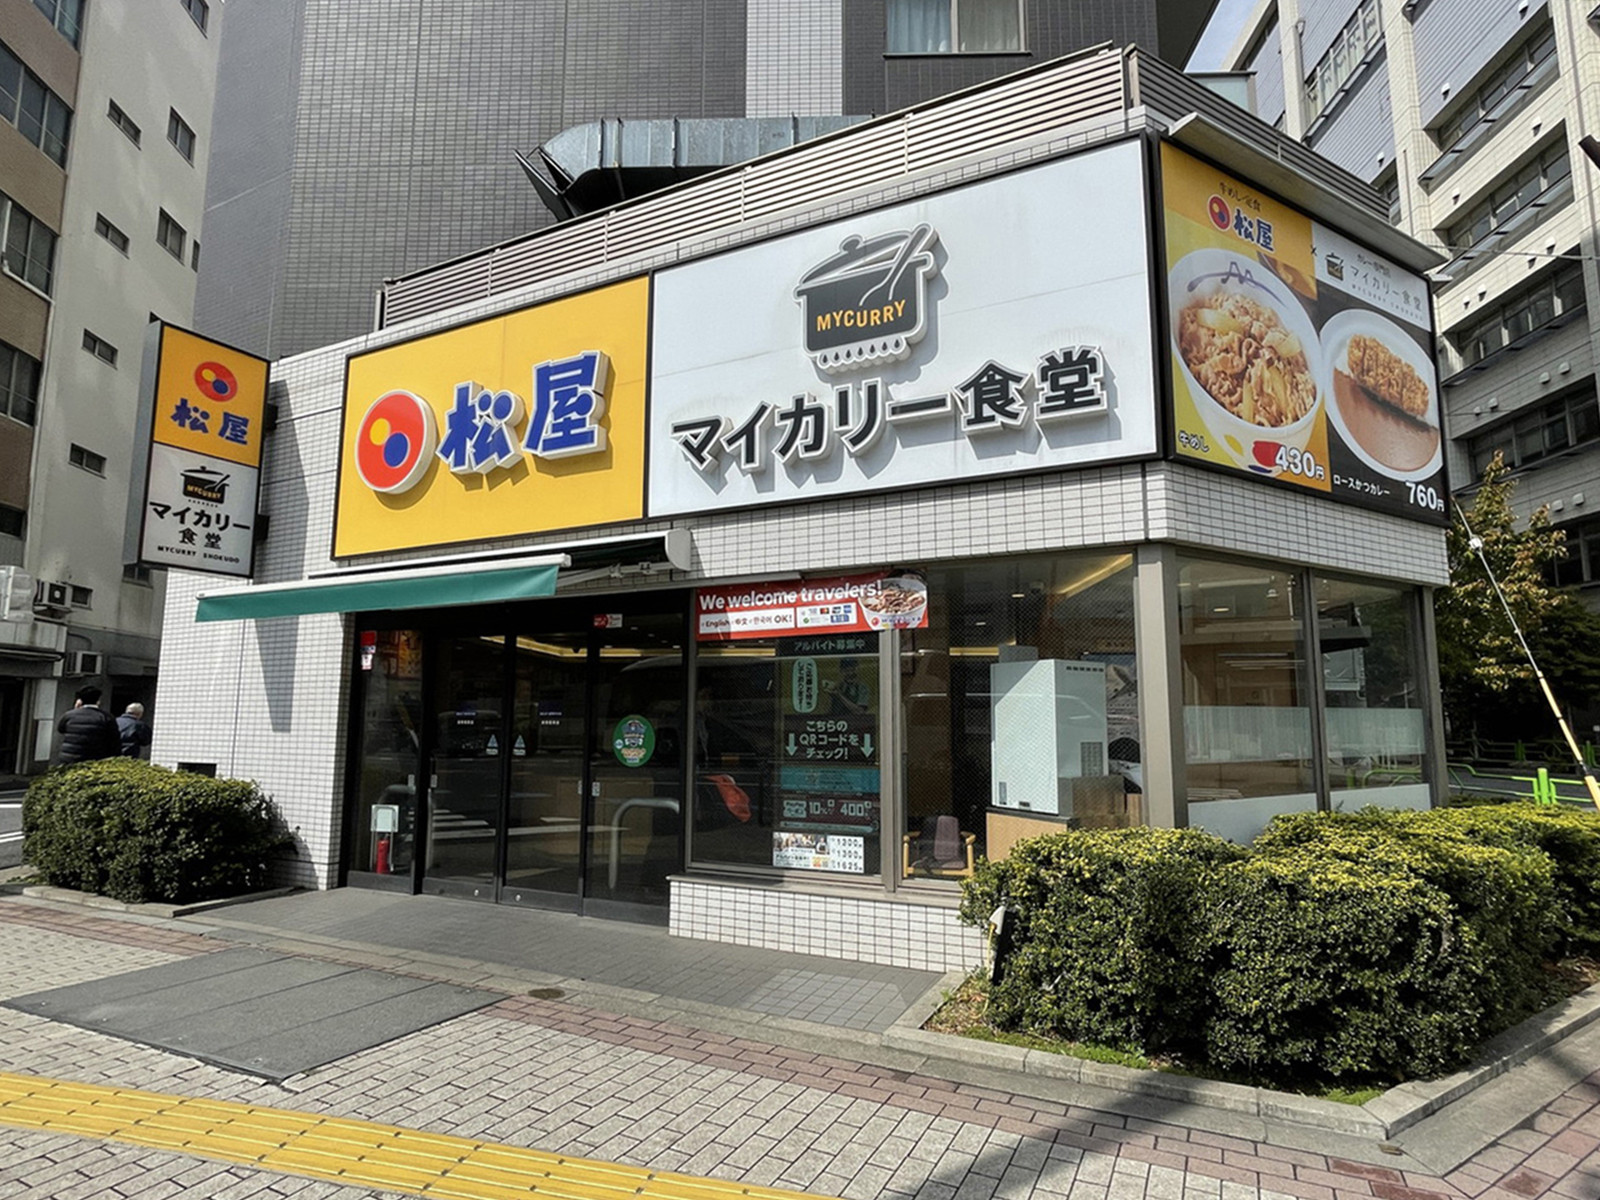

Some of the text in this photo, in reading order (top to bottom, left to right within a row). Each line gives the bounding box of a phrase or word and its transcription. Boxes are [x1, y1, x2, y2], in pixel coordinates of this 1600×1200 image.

[1233, 207, 1274, 252] 松屋
[816, 299, 906, 331] MYCURRY
[436, 350, 606, 474] 松屋
[671, 345, 1106, 470] マイカリー食堂
[170, 397, 250, 445] 松屋
[1178, 430, 1209, 453] 牛めし
[1275, 444, 1325, 481] 430円
[186, 484, 221, 499] MYCURRY
[1333, 474, 1390, 496] ロースかつカレー
[1405, 481, 1445, 512] 760円
[149, 501, 251, 531] マイカリー
[178, 527, 221, 550] 食堂
[157, 545, 240, 564] MYCURRY SHOKUDO
[700, 579, 882, 610] We welcome travelers!
[705, 619, 730, 628] English
[774, 614, 793, 623] OK!
[794, 639, 866, 651] アルバイト募集中
[806, 720, 848, 732] こちらの
[799, 733, 860, 746] QRコードを
[806, 747, 849, 759] チェック!
